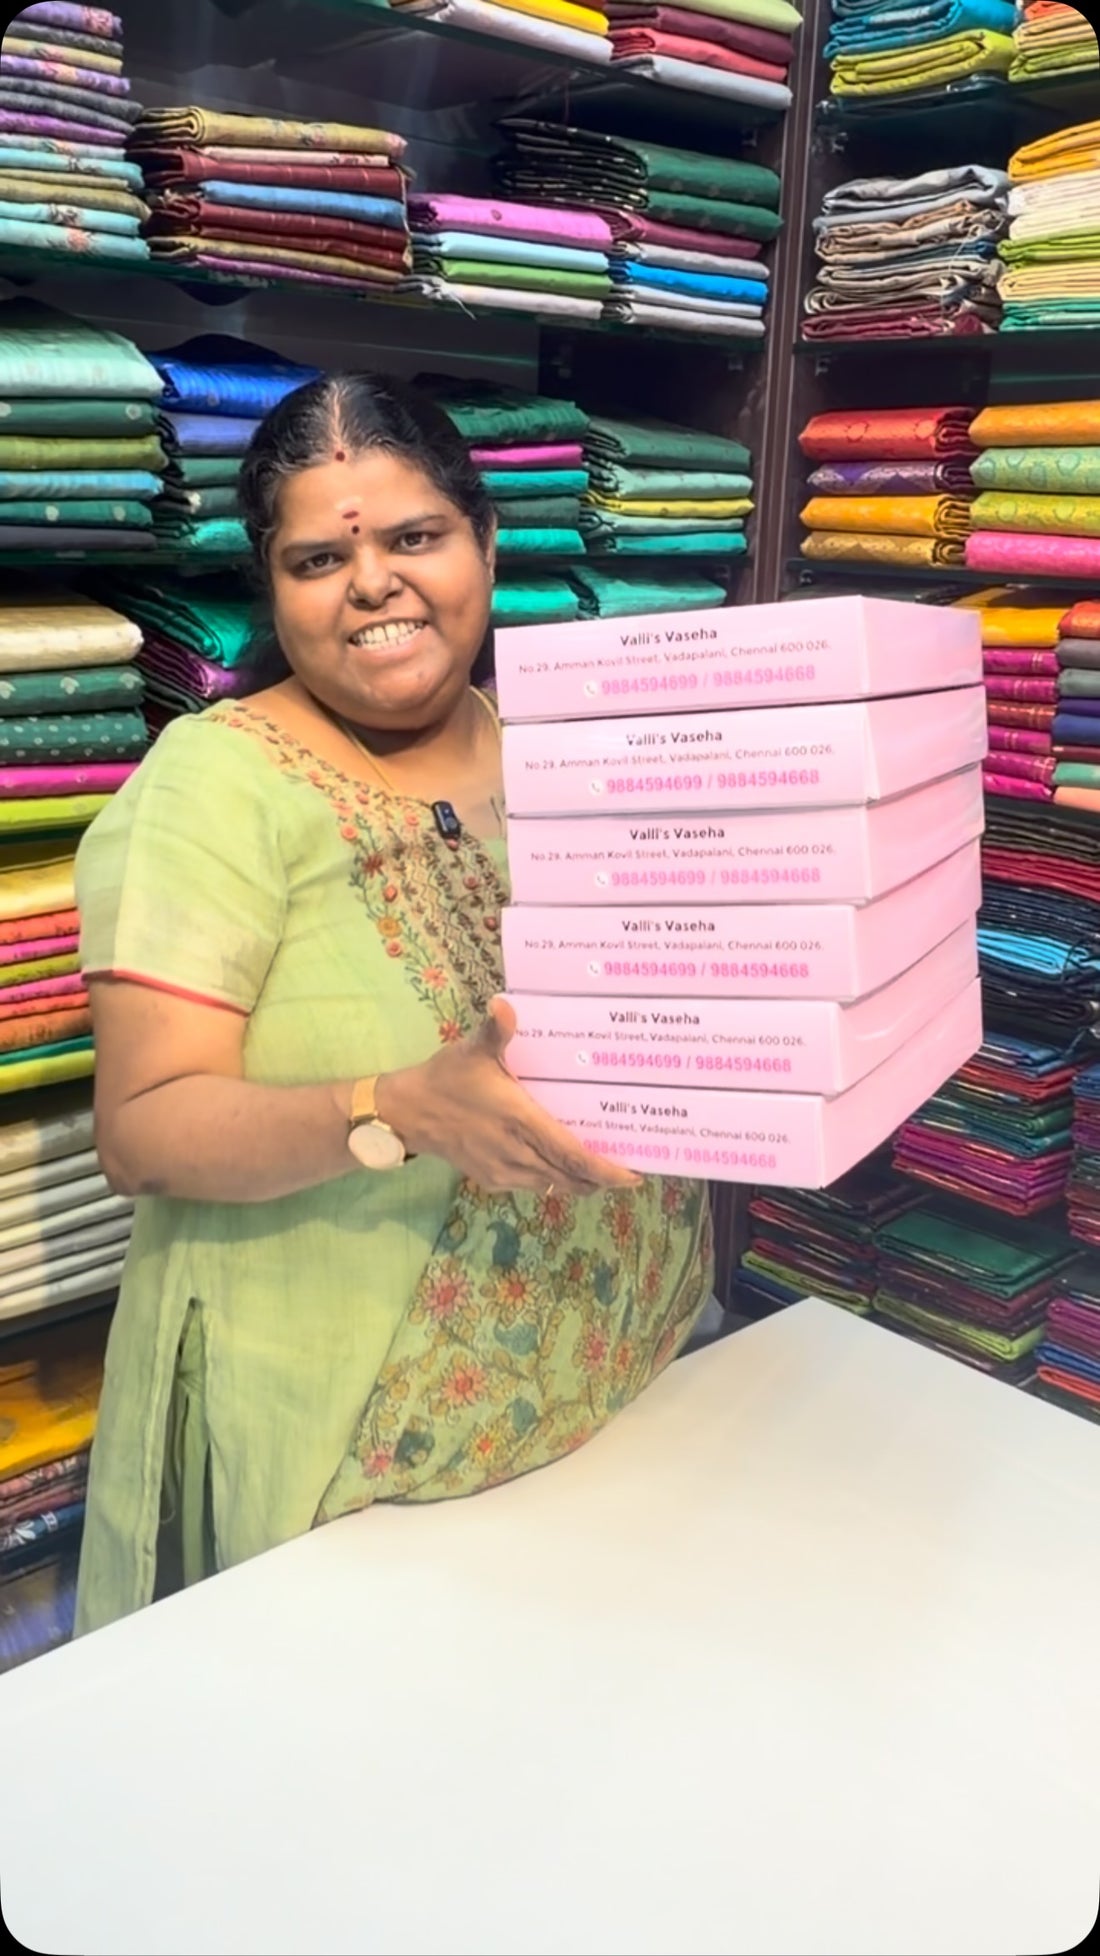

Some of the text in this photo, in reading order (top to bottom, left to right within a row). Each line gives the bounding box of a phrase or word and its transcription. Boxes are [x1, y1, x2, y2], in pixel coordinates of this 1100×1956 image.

[620, 628, 718, 647] Valli's Vaseha
[553, 659, 595, 671] Amman
[598, 656, 623, 667] Kovil
[731, 644, 778, 658] Chennai
[780, 643, 803, 653] 600
[601, 675, 698, 695] 9884594699
[713, 666, 816, 687] 9884594668
[626, 730, 722, 746] Valli's Vaseha
[560, 757, 600, 768] Amman
[603, 755, 628, 766] Kovil
[736, 748, 782, 760] Chennai
[785, 747, 808, 756] 600
[606, 776, 702, 794] 9884594699
[717, 770, 820, 789] 9884594668
[629, 827, 725, 841] Valli's Vaseha
[565, 850, 605, 860] Amman
[608, 849, 632, 859] Kovil
[738, 846, 784, 856] Chennai
[786, 845, 809, 855] 600
[611, 871, 706, 886] 9884594699
[720, 868, 821, 885] 9884594668
[622, 920, 715, 932] Valli's Vaseha
[558, 940, 598, 949] Amman
[600, 940, 625, 950] Kovil
[728, 940, 773, 951] Chennai
[775, 940, 798, 950] 600
[604, 962, 697, 977] 9884594699
[710, 963, 809, 978] 9884594668
[609, 1011, 700, 1025] Valli's Vaseha
[548, 1030, 586, 1040] Amman
[588, 1030, 612, 1041] Kovil
[712, 1034, 756, 1045] Chennai
[758, 1035, 780, 1046] 600
[592, 1052, 681, 1069] 9884594699
[695, 1056, 792, 1073] 9884594668
[600, 1101, 688, 1118] Valli's Vaseha
[579, 1119, 603, 1129] Kovil
[700, 1128, 742, 1140] Chennai
[744, 1131, 766, 1142] 600
[583, 1139, 671, 1161] 9884594699
[683, 1148, 777, 1169] 9884594668
